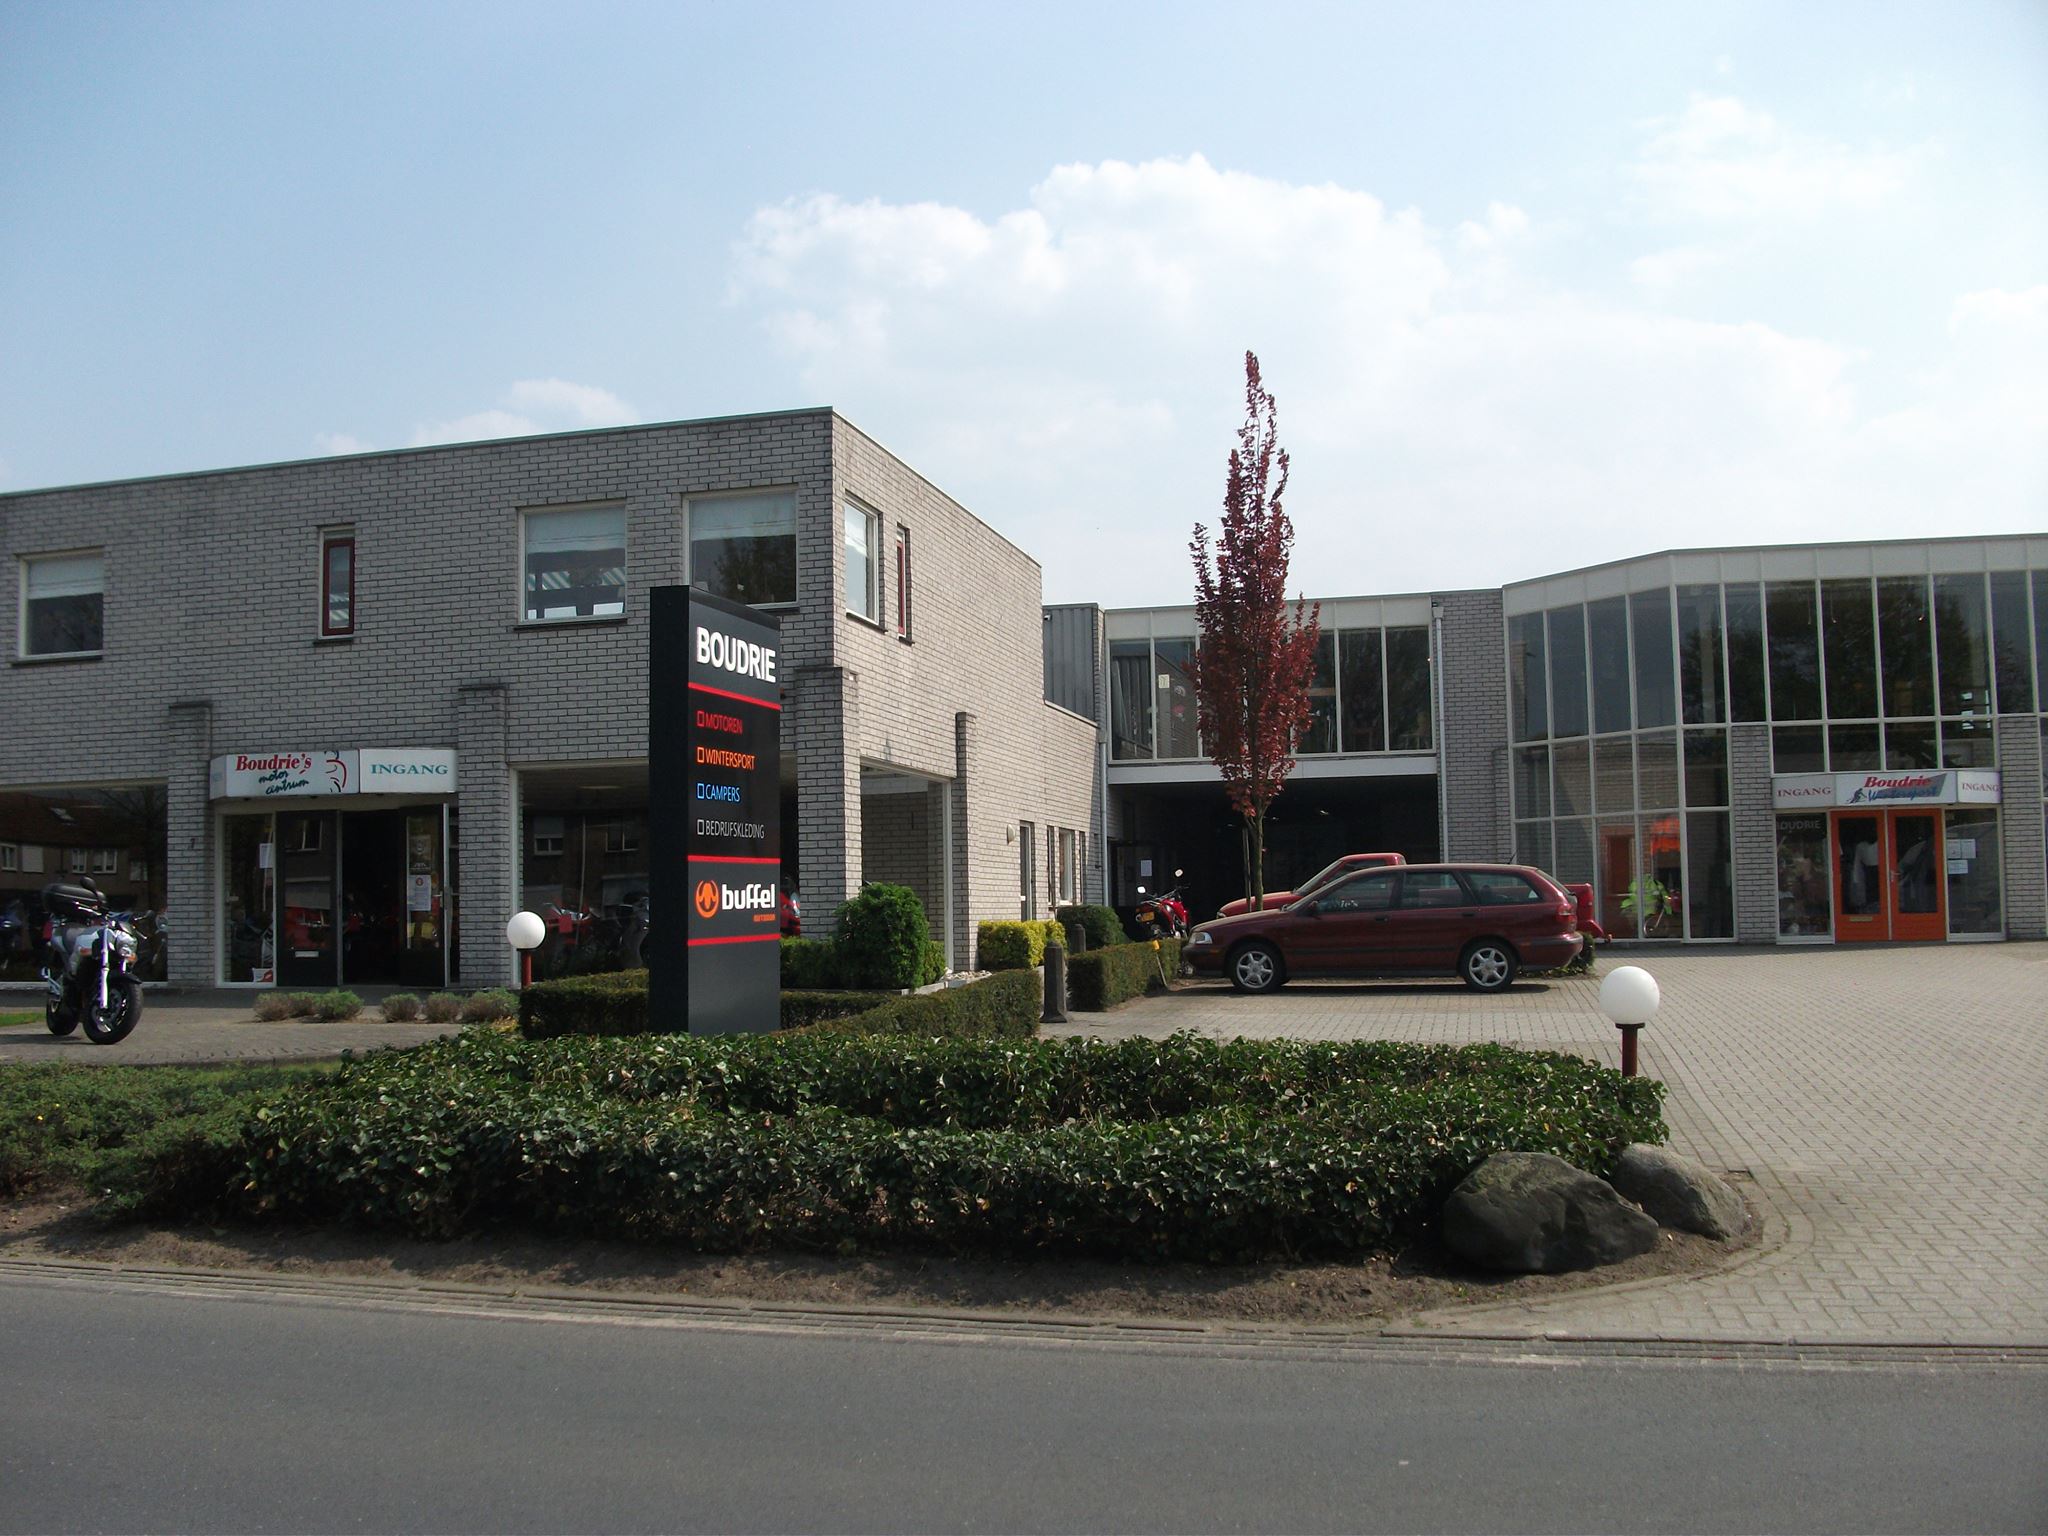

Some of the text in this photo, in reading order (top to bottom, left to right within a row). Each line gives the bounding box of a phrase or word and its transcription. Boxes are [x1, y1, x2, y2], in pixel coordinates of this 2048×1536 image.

[696, 626, 776, 683] BOUDRIE
[705, 712, 743, 734] MOTOREN
[235, 753, 312, 771] Boudrie's
[705, 747, 755, 770] WINTERSPORT
[370, 763, 449, 775] INGANG
[1864, 775, 1930, 788] Boudrie
[1962, 782, 2000, 793] INGANG
[705, 784, 740, 802] CAMPERS
[1777, 786, 1831, 797] INGANG
[705, 820, 765, 839] BEDRIJFSKLEDING
[721, 883, 775, 910] buffel
